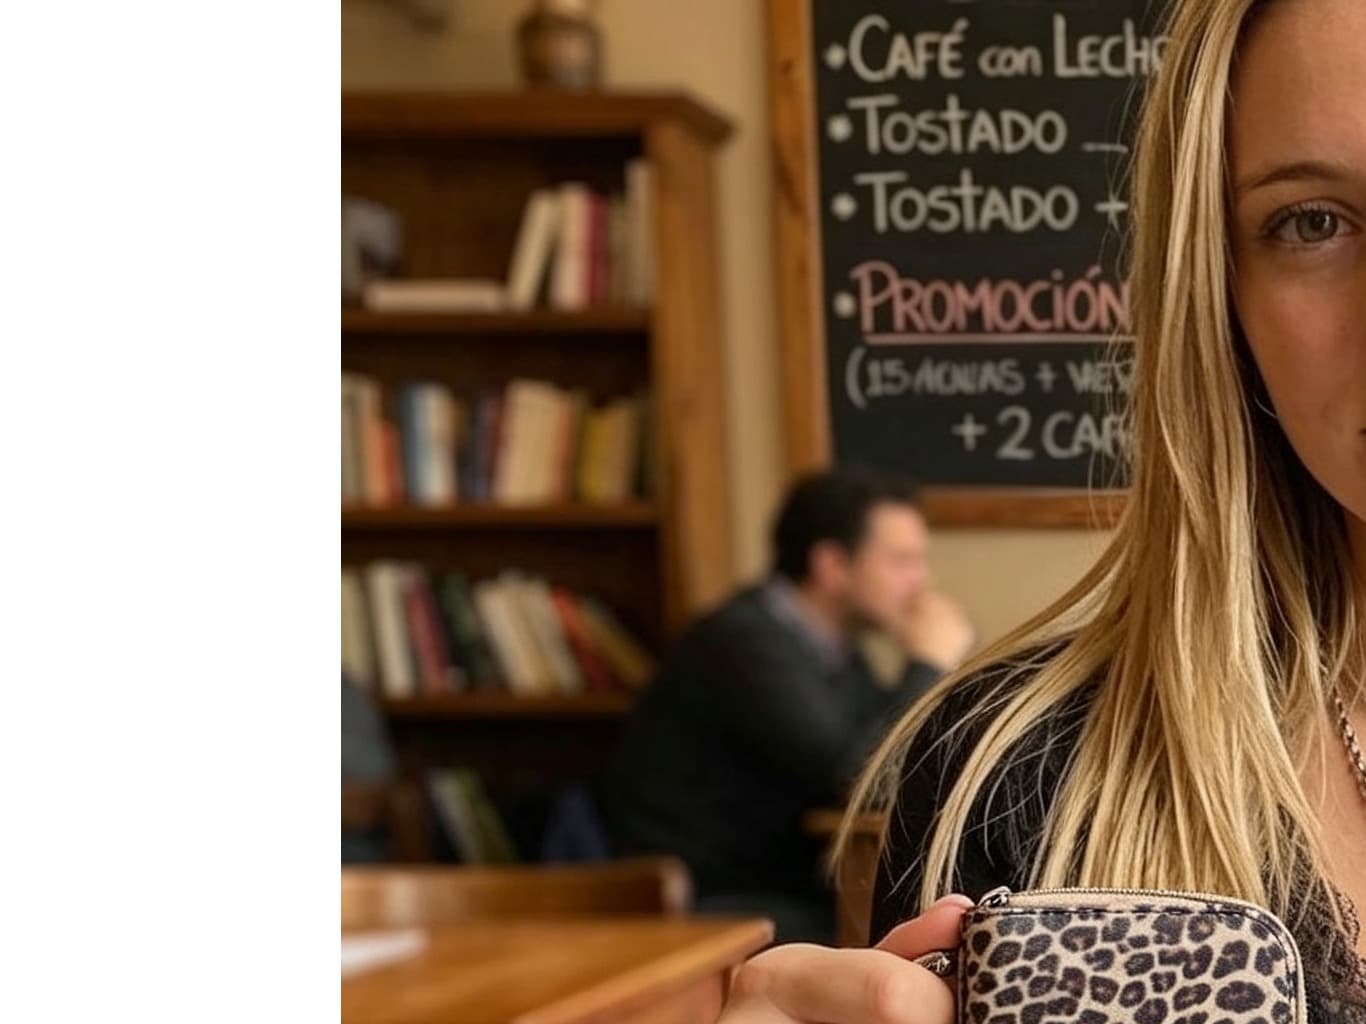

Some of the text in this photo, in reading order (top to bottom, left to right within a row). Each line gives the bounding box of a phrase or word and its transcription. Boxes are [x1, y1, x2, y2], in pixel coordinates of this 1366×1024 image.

[848, 14, 968, 82] CAFÉ
[978, 45, 1042, 77] con
[995, 405, 1035, 461] 2
